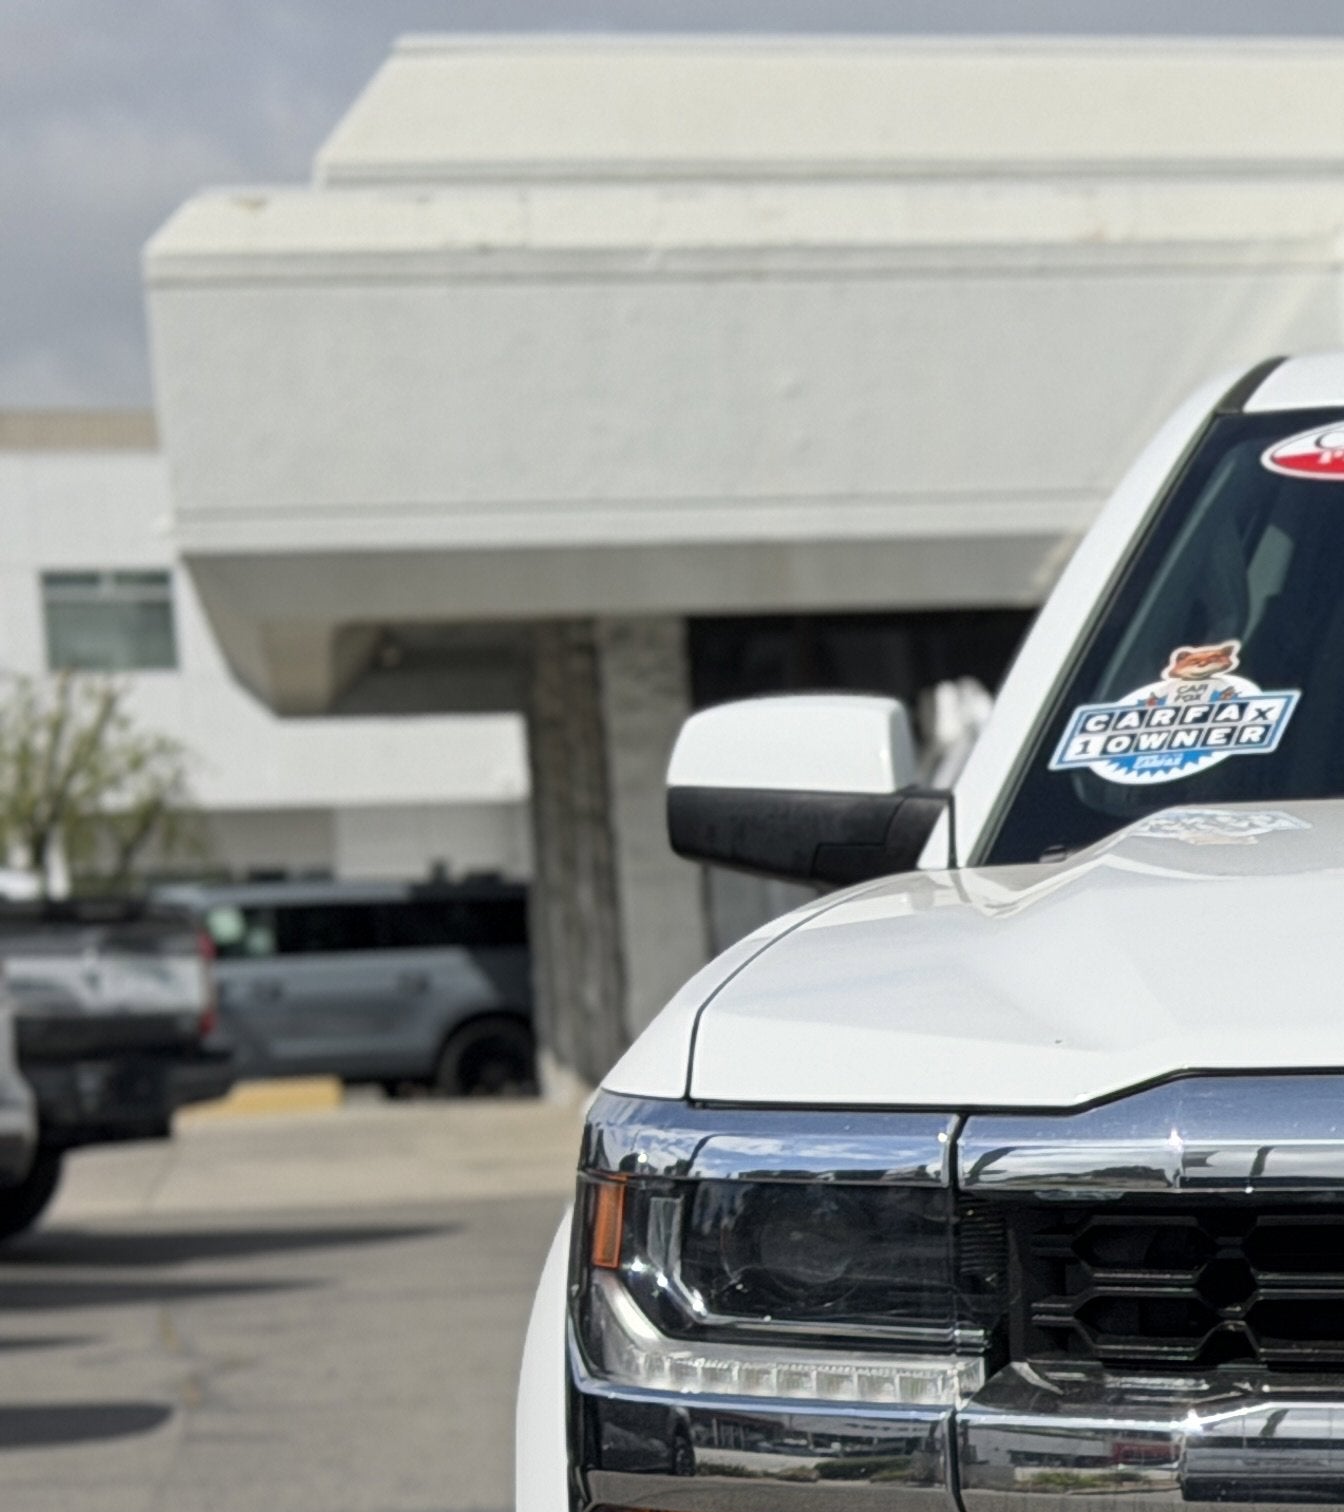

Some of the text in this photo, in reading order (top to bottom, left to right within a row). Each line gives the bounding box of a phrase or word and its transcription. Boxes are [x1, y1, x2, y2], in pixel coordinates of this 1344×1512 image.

[1085, 703, 1276, 733] CARFAX
[1074, 725, 1265, 756] 1 OWNER
